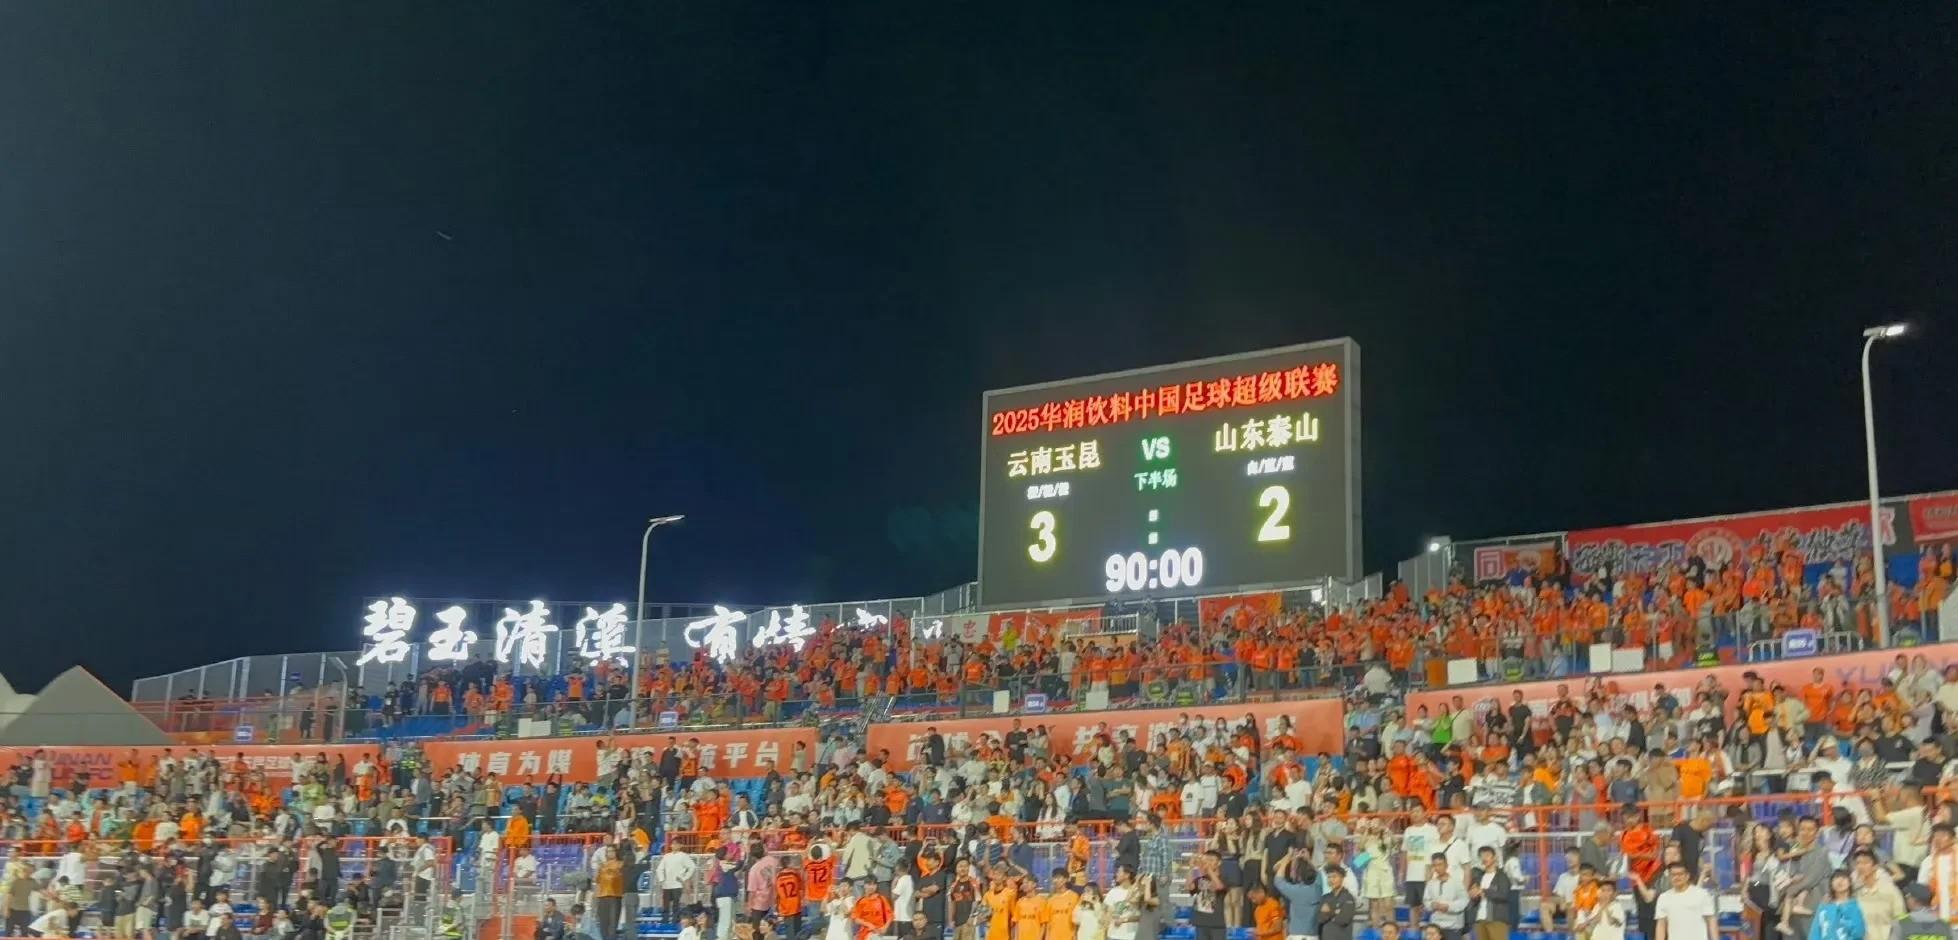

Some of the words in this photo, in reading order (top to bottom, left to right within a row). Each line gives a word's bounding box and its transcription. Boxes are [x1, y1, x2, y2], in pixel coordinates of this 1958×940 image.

[992, 363, 1339, 436] 2025华润饮料中国足球超级联赛
[1141, 436, 1171, 461] VS
[1215, 412, 1319, 453] 山东泰山
[1007, 439, 1101, 478] 云南玉昆
[1134, 468, 1178, 491] 下半场
[1028, 510, 1057, 563] 3
[1257, 485, 1290, 542] 2
[1105, 547, 1204, 593] 90:00
[356, 597, 636, 669] 碧玉清溪
[780, 881, 798, 898] 12
[810, 867, 827, 883] 12
